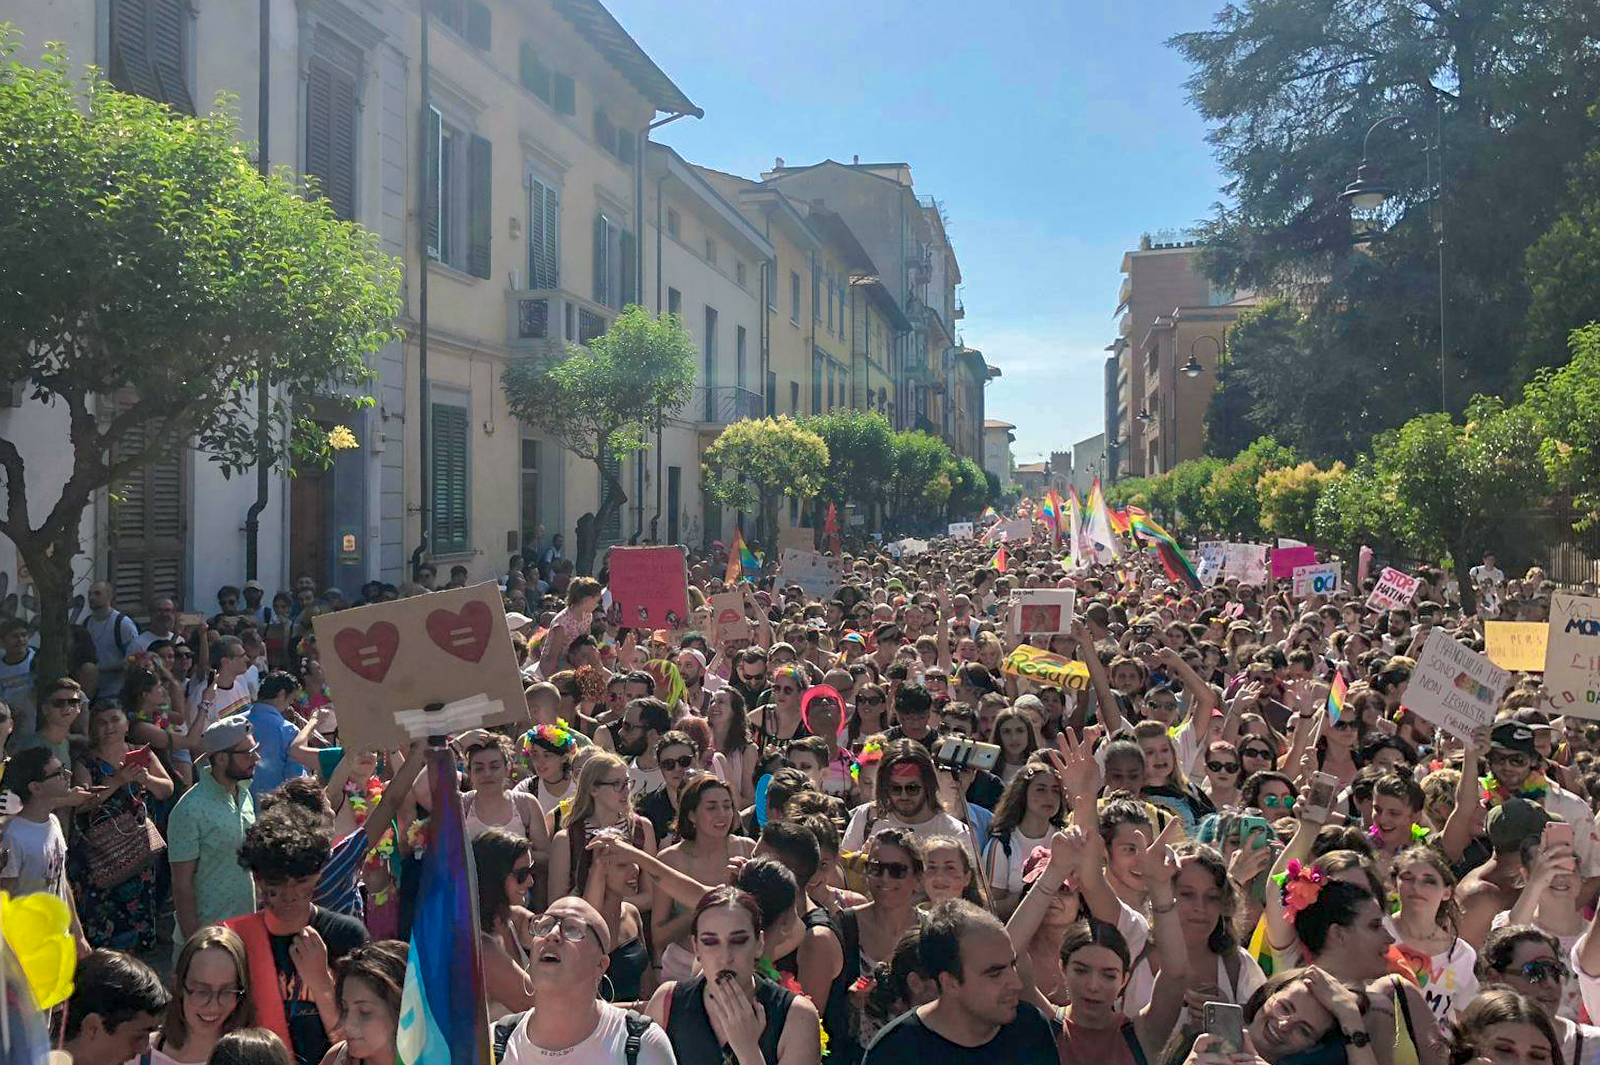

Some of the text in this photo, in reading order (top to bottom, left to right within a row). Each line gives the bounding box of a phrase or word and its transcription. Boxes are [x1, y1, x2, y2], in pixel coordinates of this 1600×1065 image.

[1383, 570, 1415, 590] STOP
[1376, 582, 1411, 605] HATING
[1427, 655, 1456, 679] SONO
[1419, 674, 1485, 722] NON LEGHISTA
